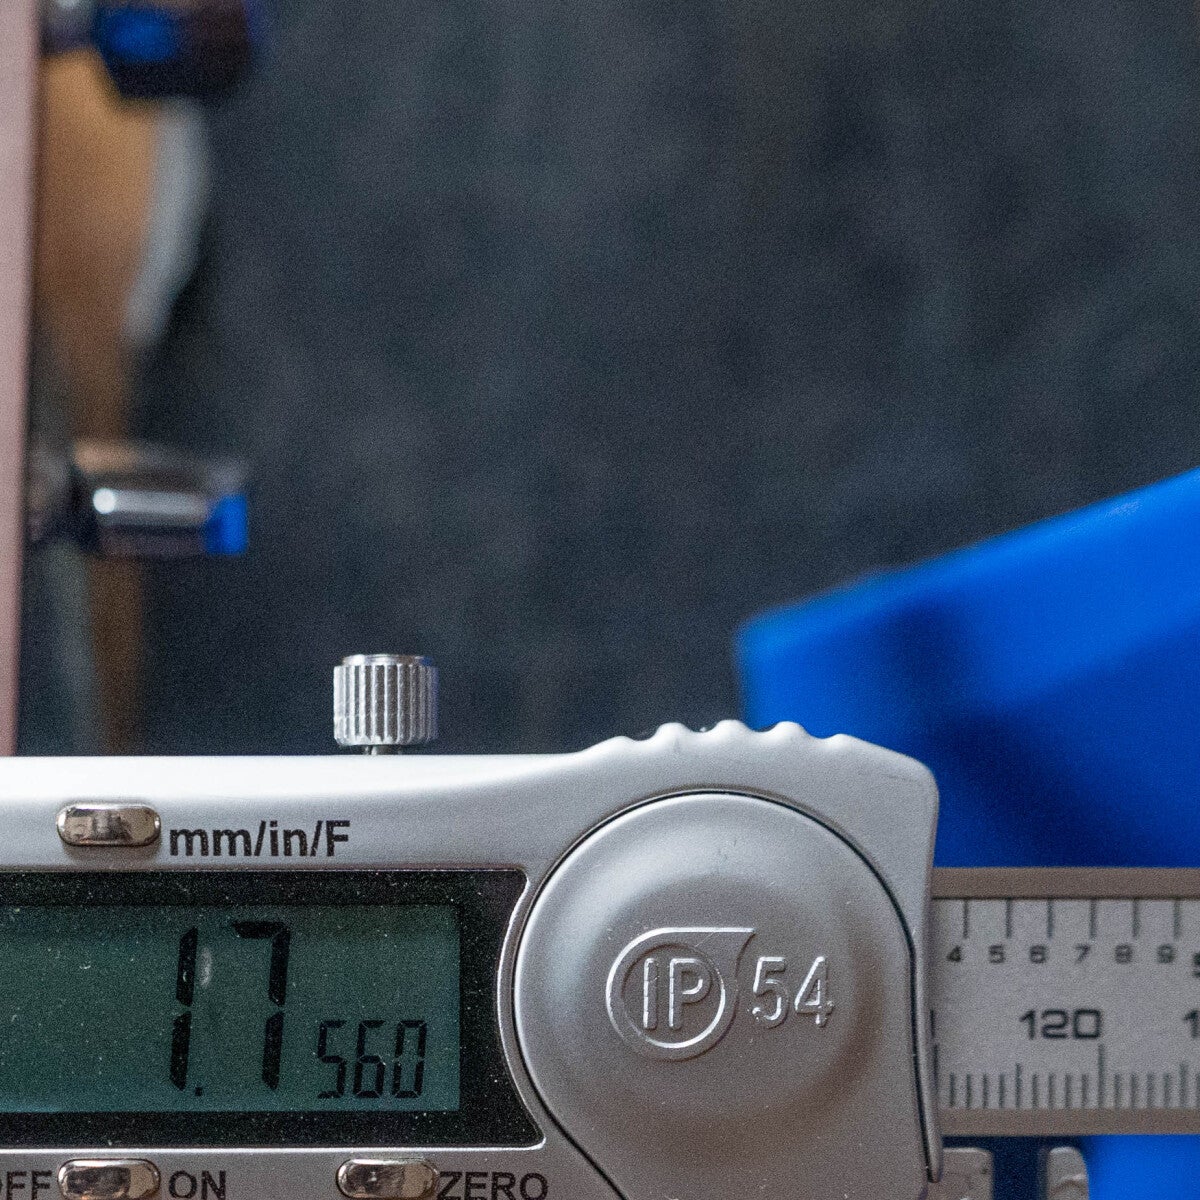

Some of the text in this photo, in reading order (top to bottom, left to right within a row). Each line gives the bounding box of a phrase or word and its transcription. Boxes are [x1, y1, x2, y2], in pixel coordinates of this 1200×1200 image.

[169, 820, 352, 857] mm/in/F
[946, 944, 1175, 964] 4 5 6 7 8 9
[642, 955, 836, 1031] IP 54
[1019, 1008, 1101, 1040] 120
[168, 1170, 226, 1200] ON
